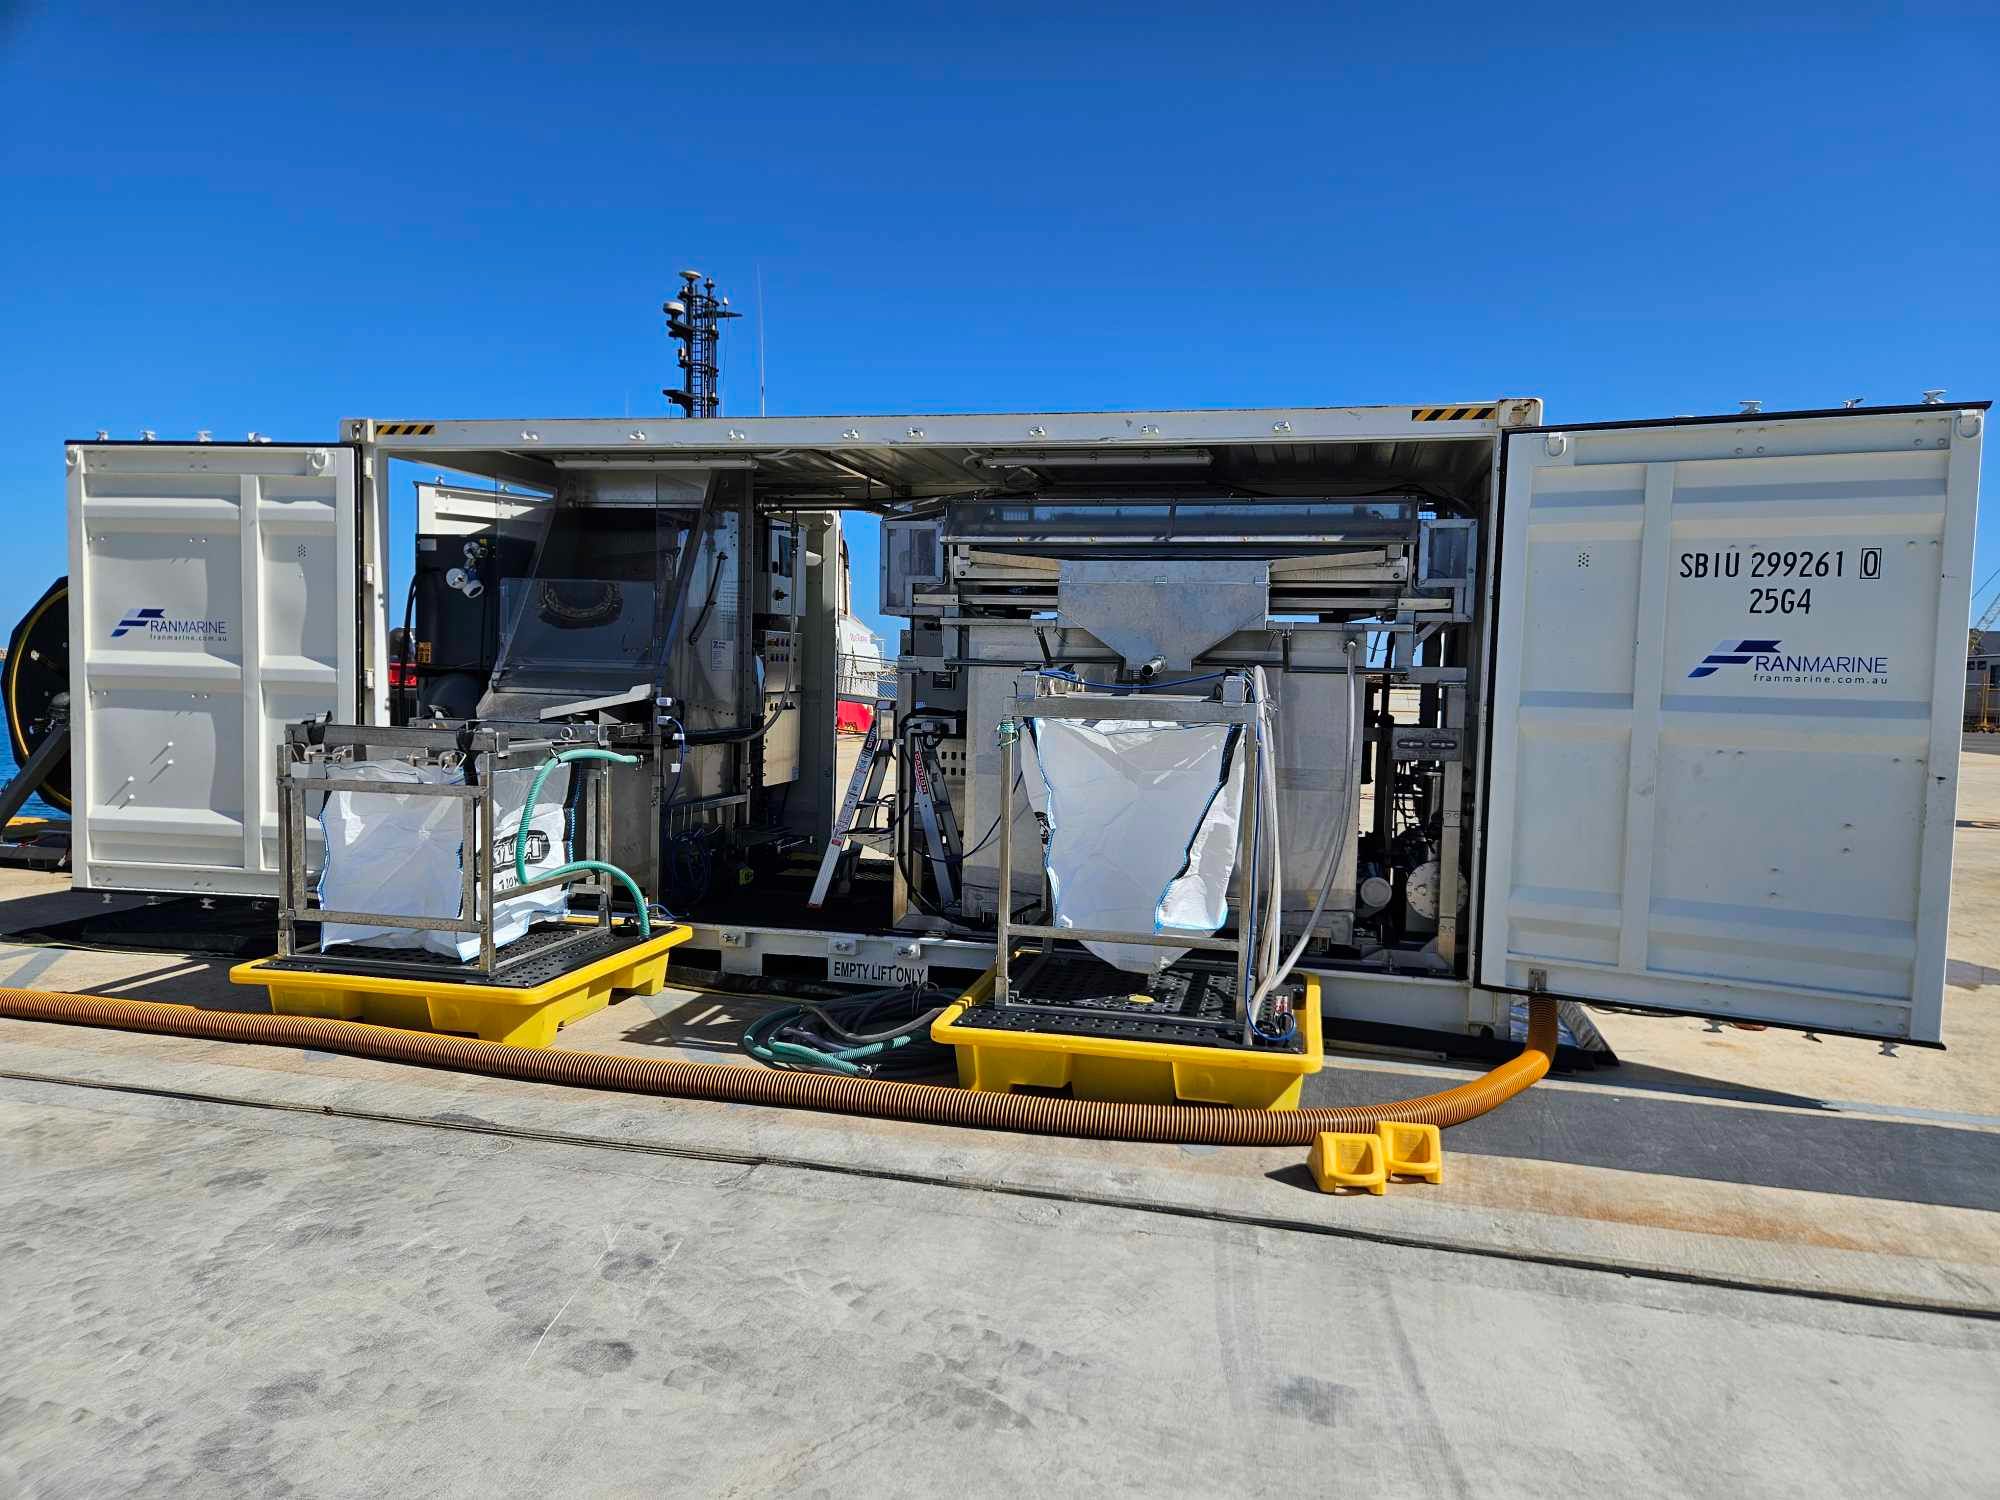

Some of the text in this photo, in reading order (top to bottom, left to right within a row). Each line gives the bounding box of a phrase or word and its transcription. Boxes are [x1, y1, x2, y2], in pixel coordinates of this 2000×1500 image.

[1680, 550, 1879, 578] SBIU 299261 0
[1749, 588, 1811, 615] 25G4
[1753, 673, 1888, 685] franmarine.com.au
[834, 961, 925, 984] EMPTY LIFT ONLY
